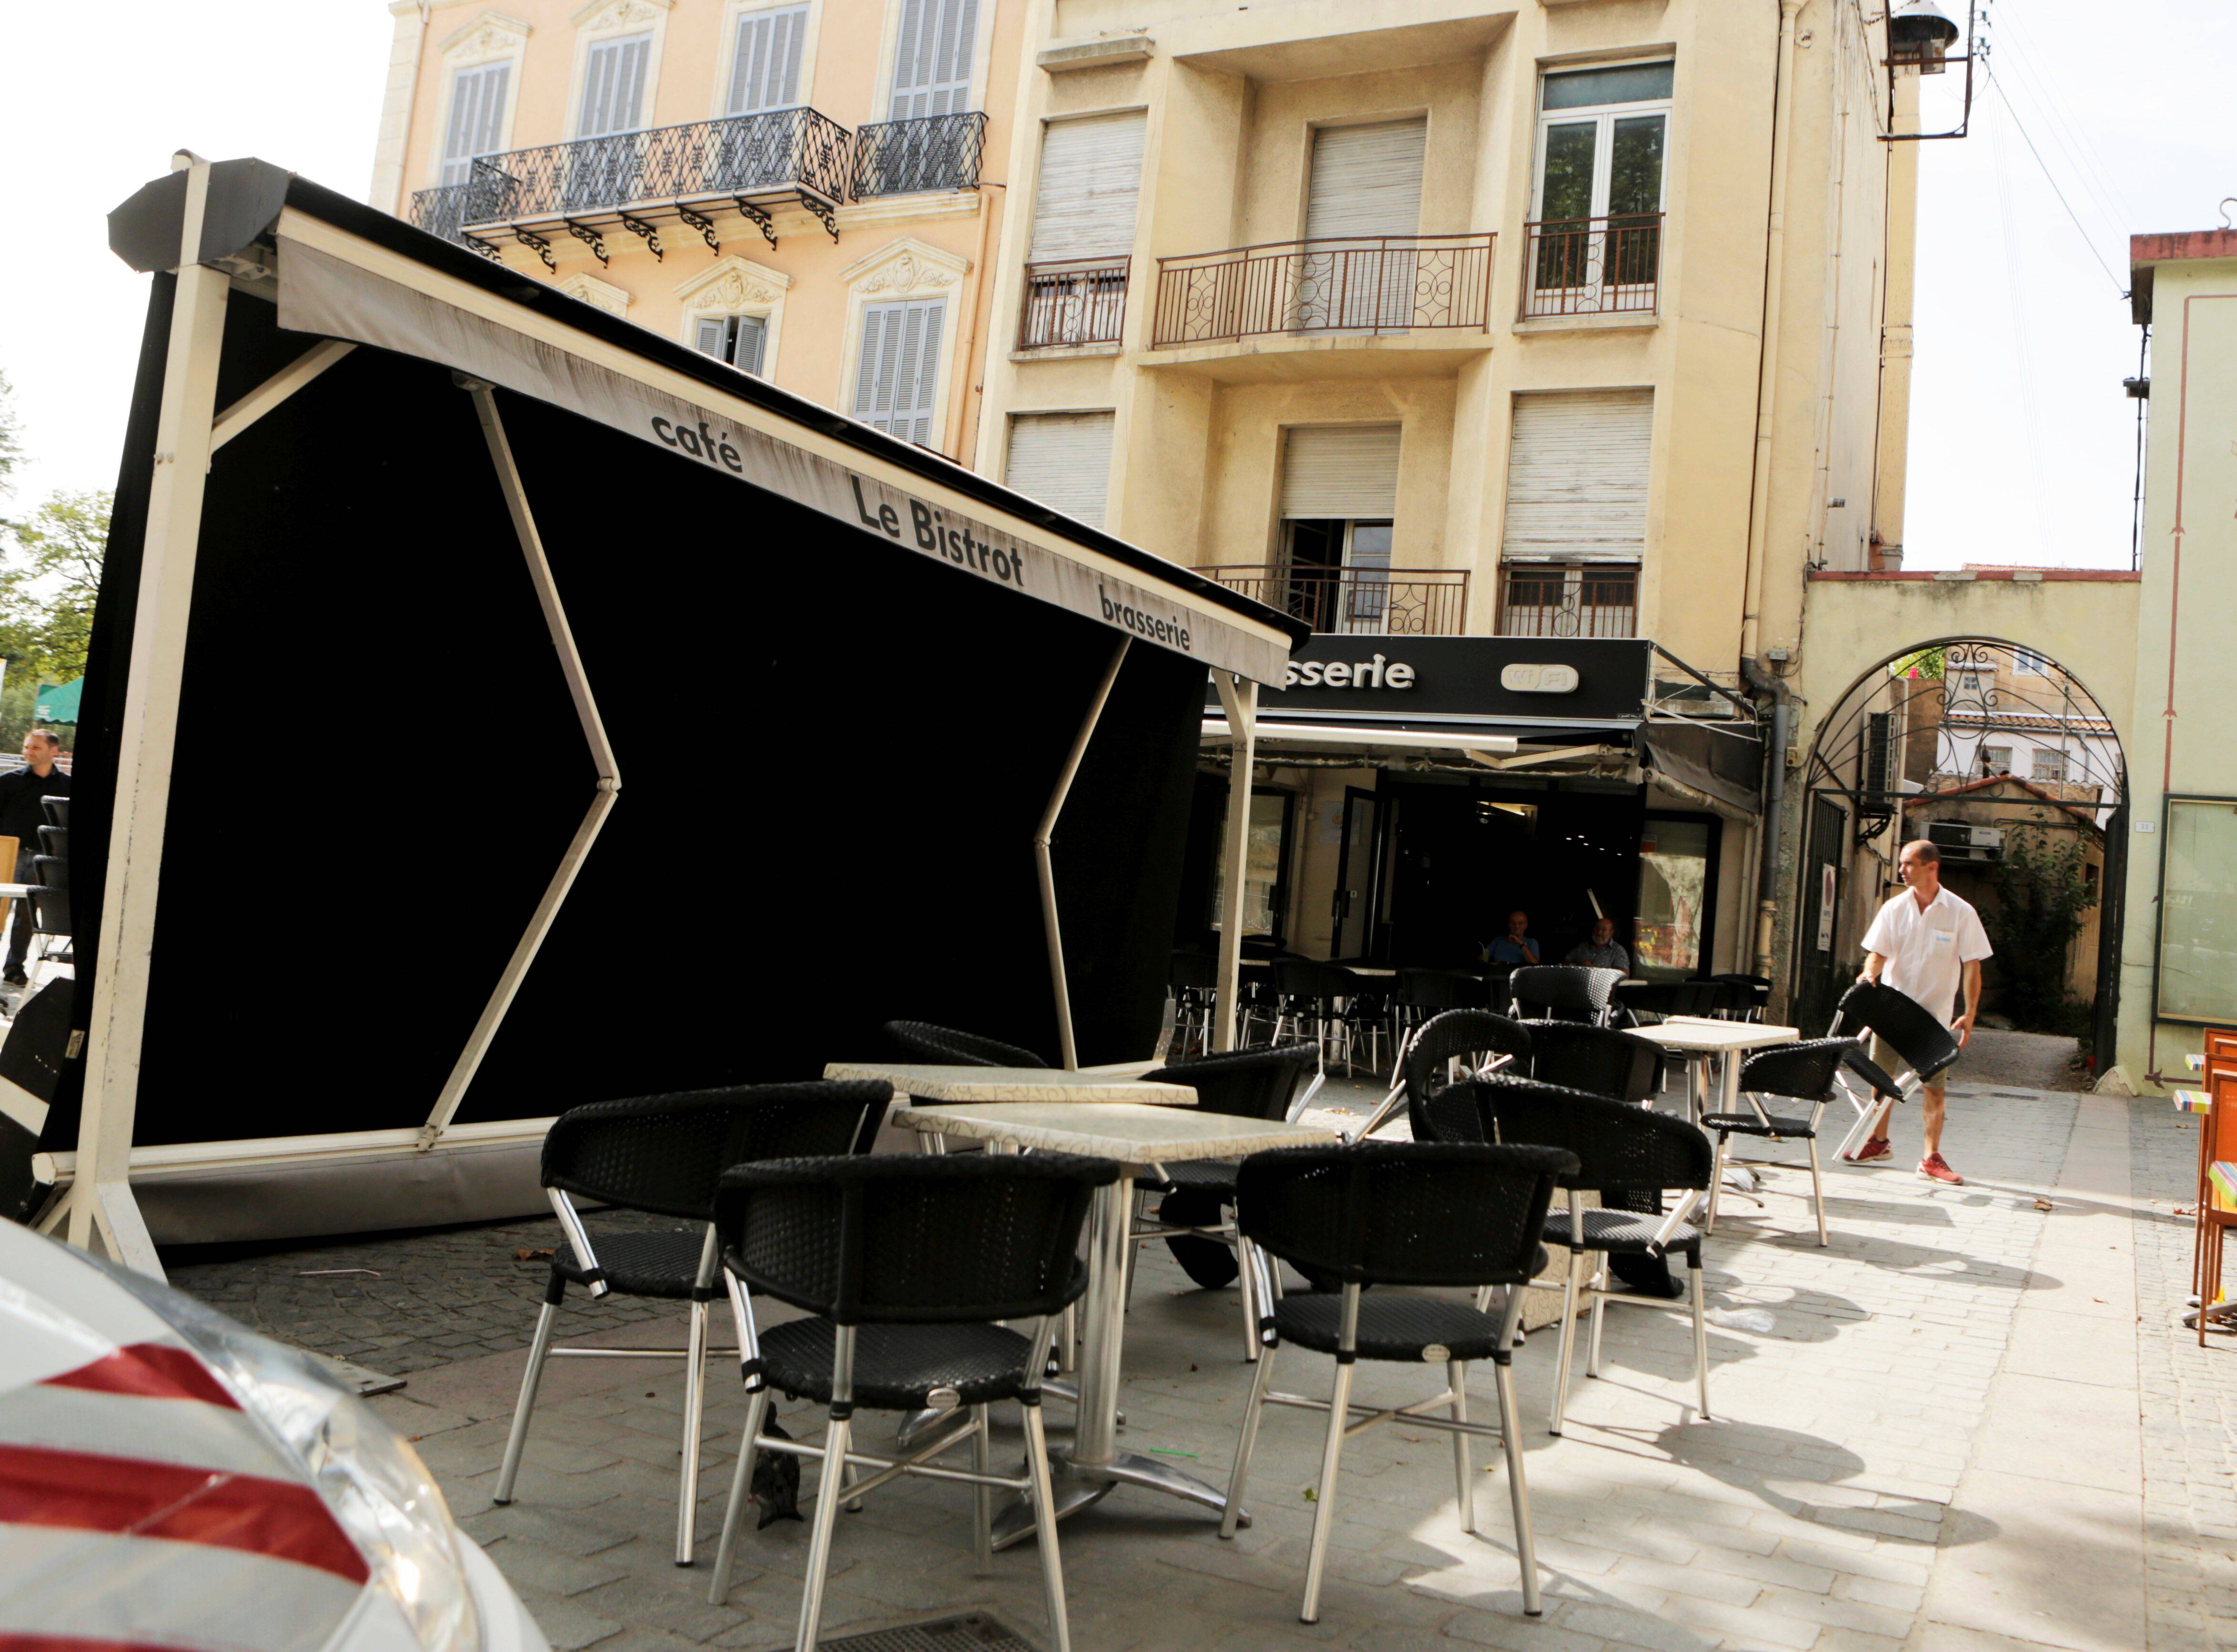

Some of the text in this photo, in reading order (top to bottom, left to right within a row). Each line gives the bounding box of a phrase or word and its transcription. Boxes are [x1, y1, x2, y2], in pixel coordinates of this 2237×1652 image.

[651, 416, 1190, 651] café Le Bistrot brasserie
[1208, 653, 1415, 688] sserie
